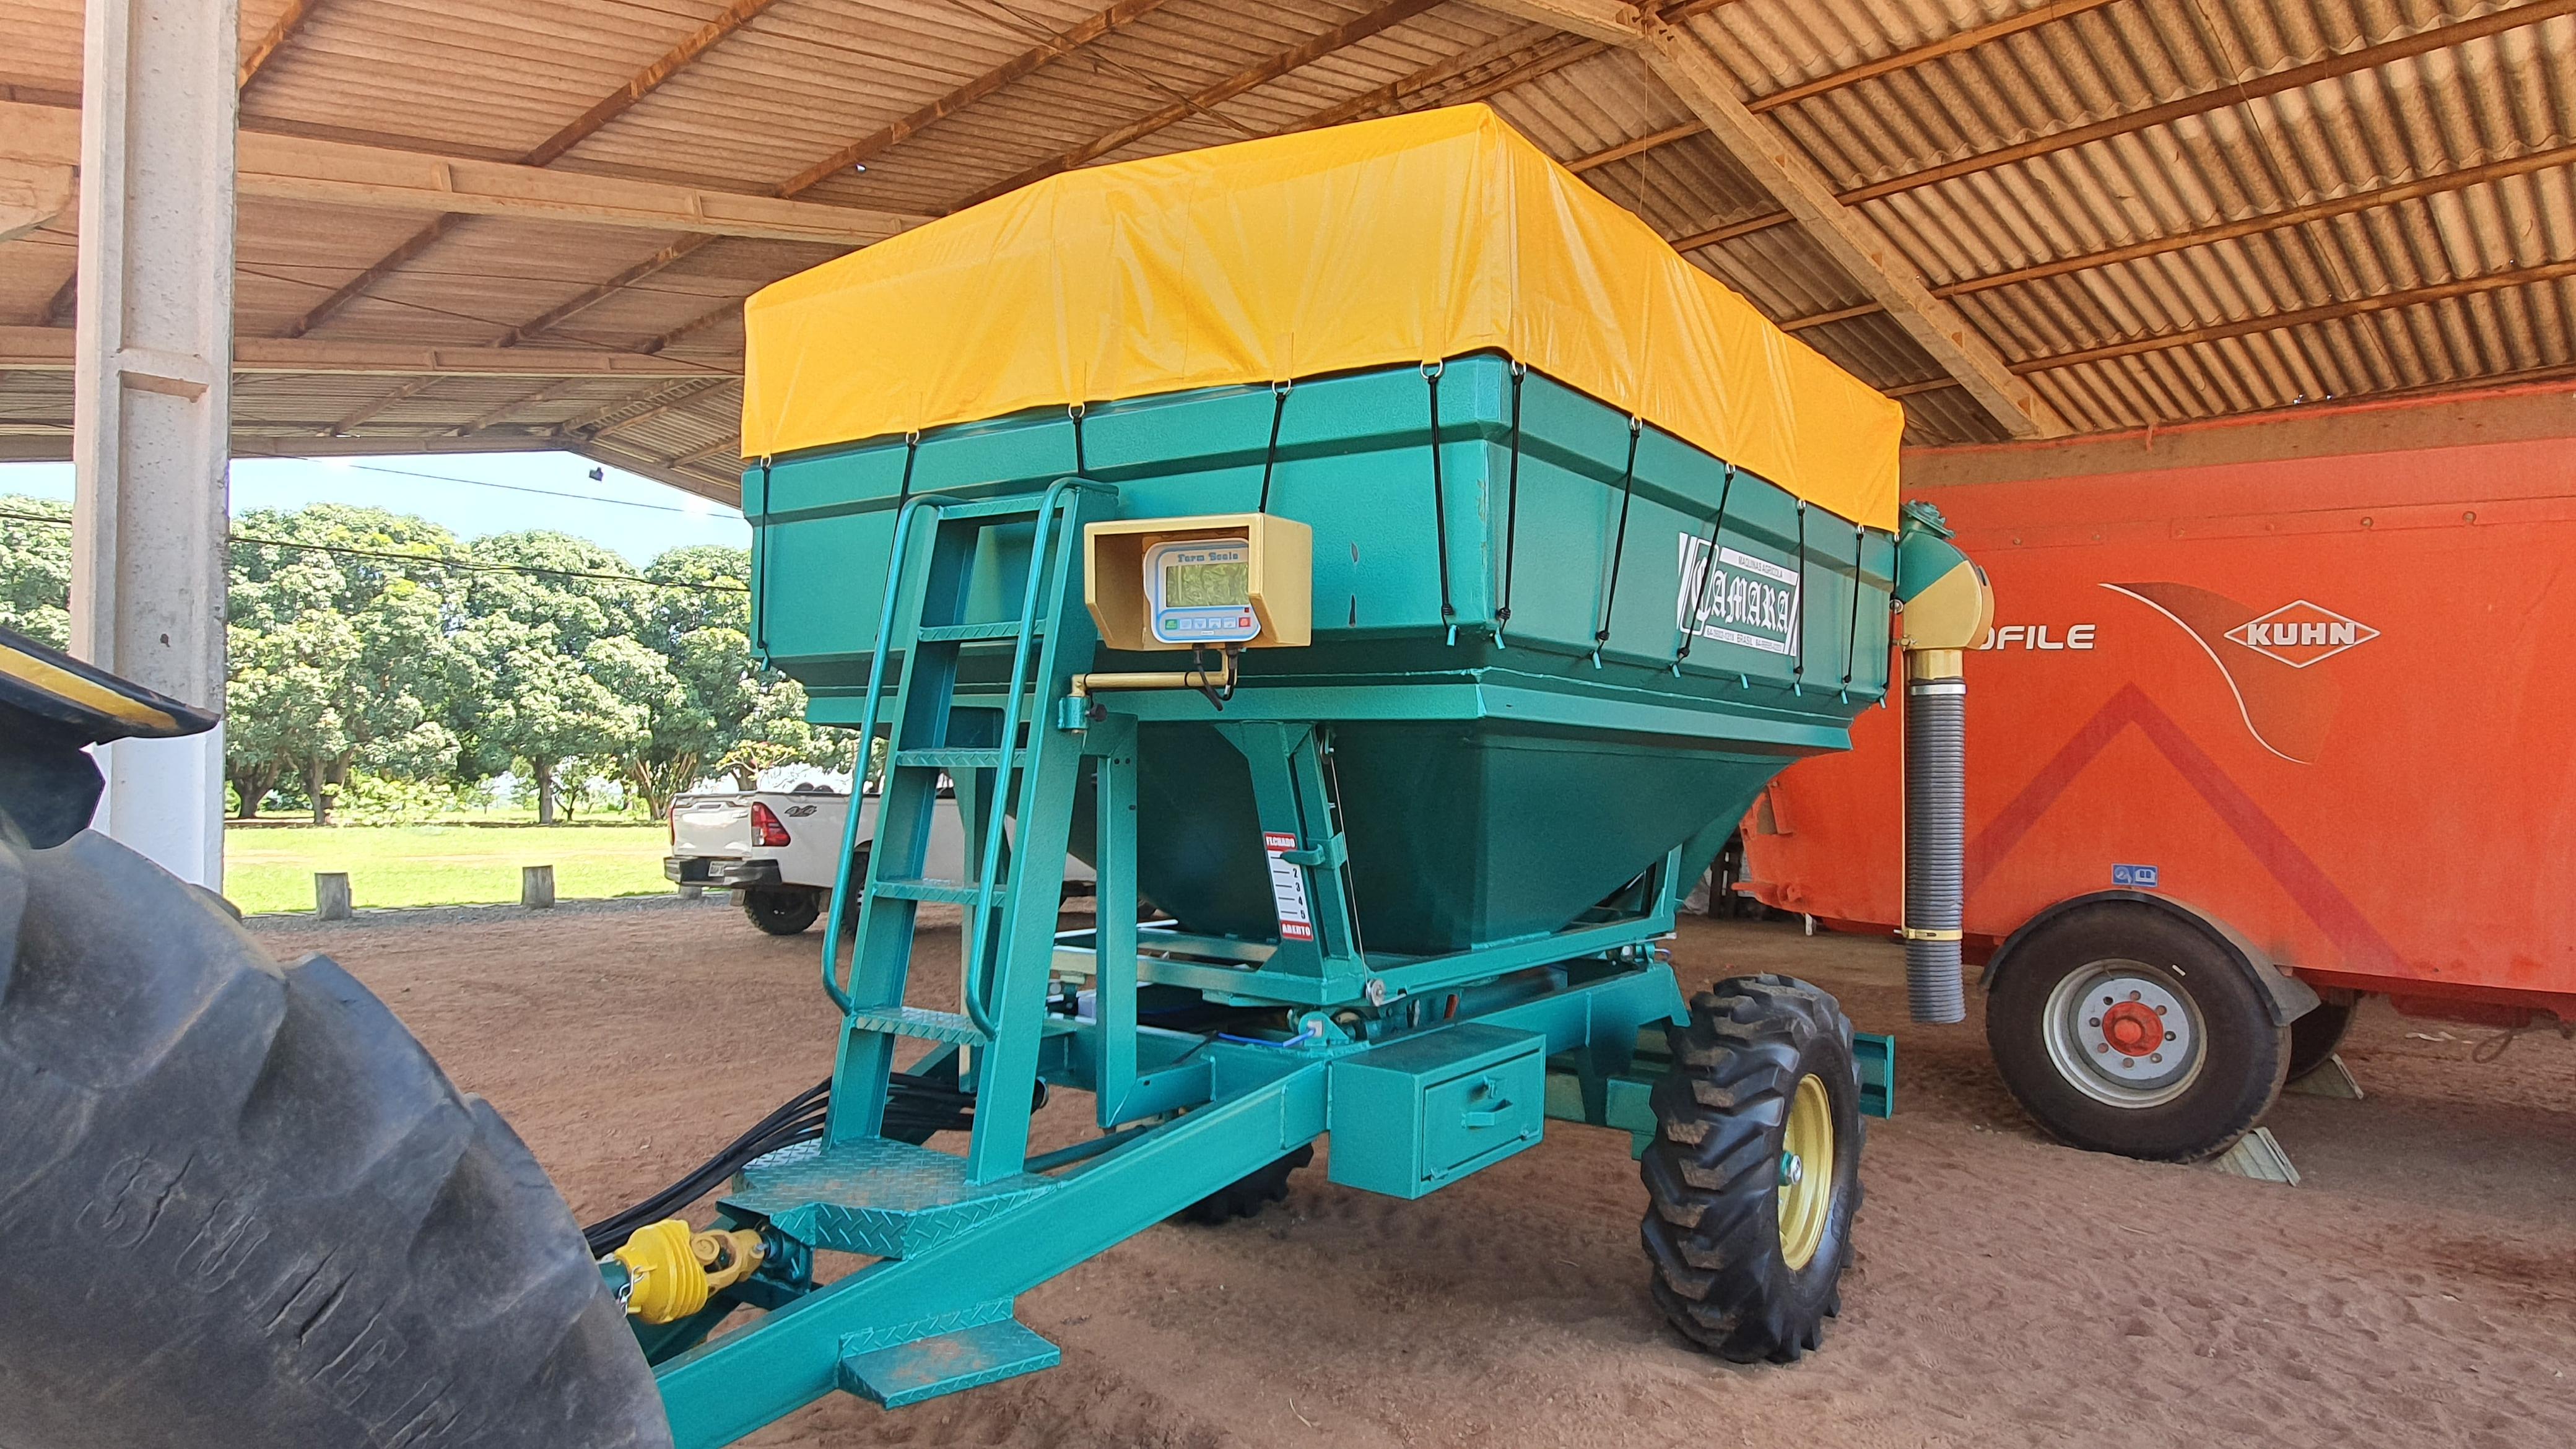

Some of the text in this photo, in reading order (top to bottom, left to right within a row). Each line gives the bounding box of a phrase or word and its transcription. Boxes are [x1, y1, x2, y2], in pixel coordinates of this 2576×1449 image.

[1178, 551, 1239, 563] Farm Scale
[2247, 622, 2356, 646] KUHN
[1292, 868, 1298, 878] 2
[1295, 882, 1301, 892] 3
[1298, 896, 1303, 906] 4
[1300, 910, 1306, 920] 5
[1282, 923, 1311, 936] ABERTO
